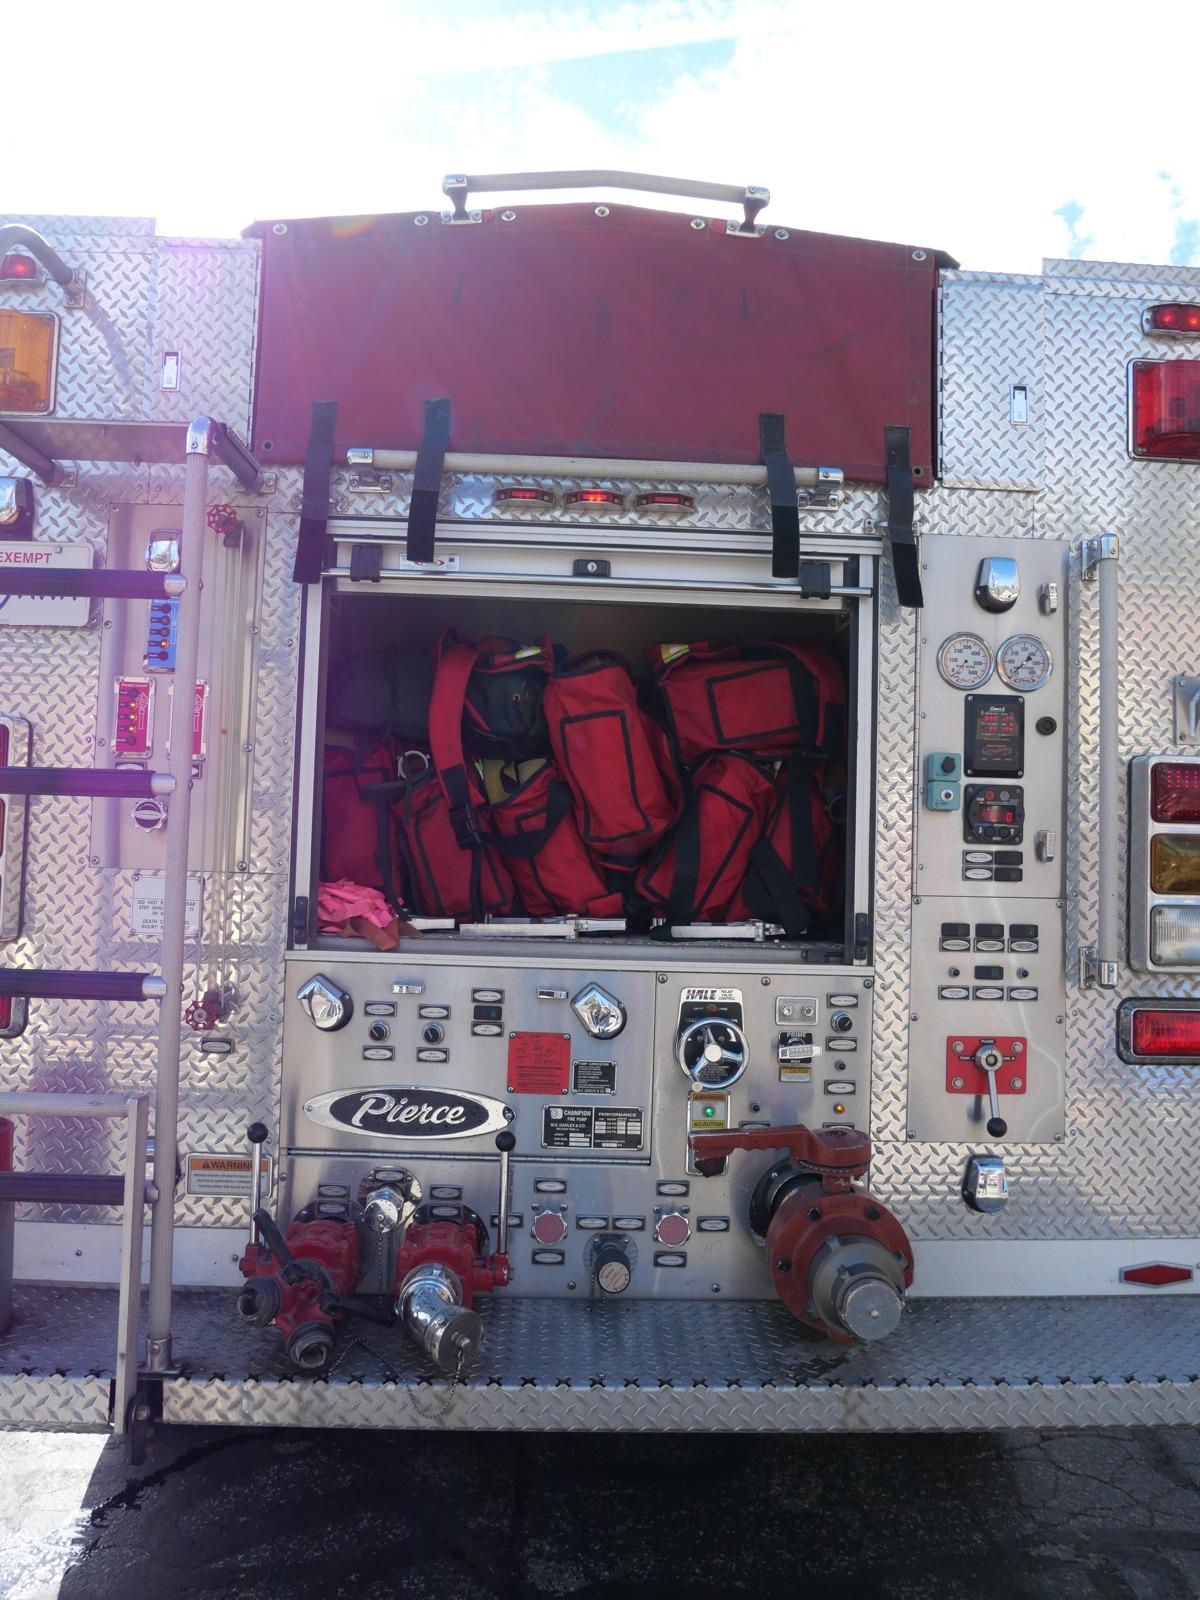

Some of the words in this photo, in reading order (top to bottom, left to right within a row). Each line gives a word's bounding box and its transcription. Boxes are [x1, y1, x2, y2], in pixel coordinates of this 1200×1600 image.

[686, 989, 717, 1000] HALE
[351, 1093, 467, 1127] Pierce
[563, 1109, 592, 1117] CHAMPION
